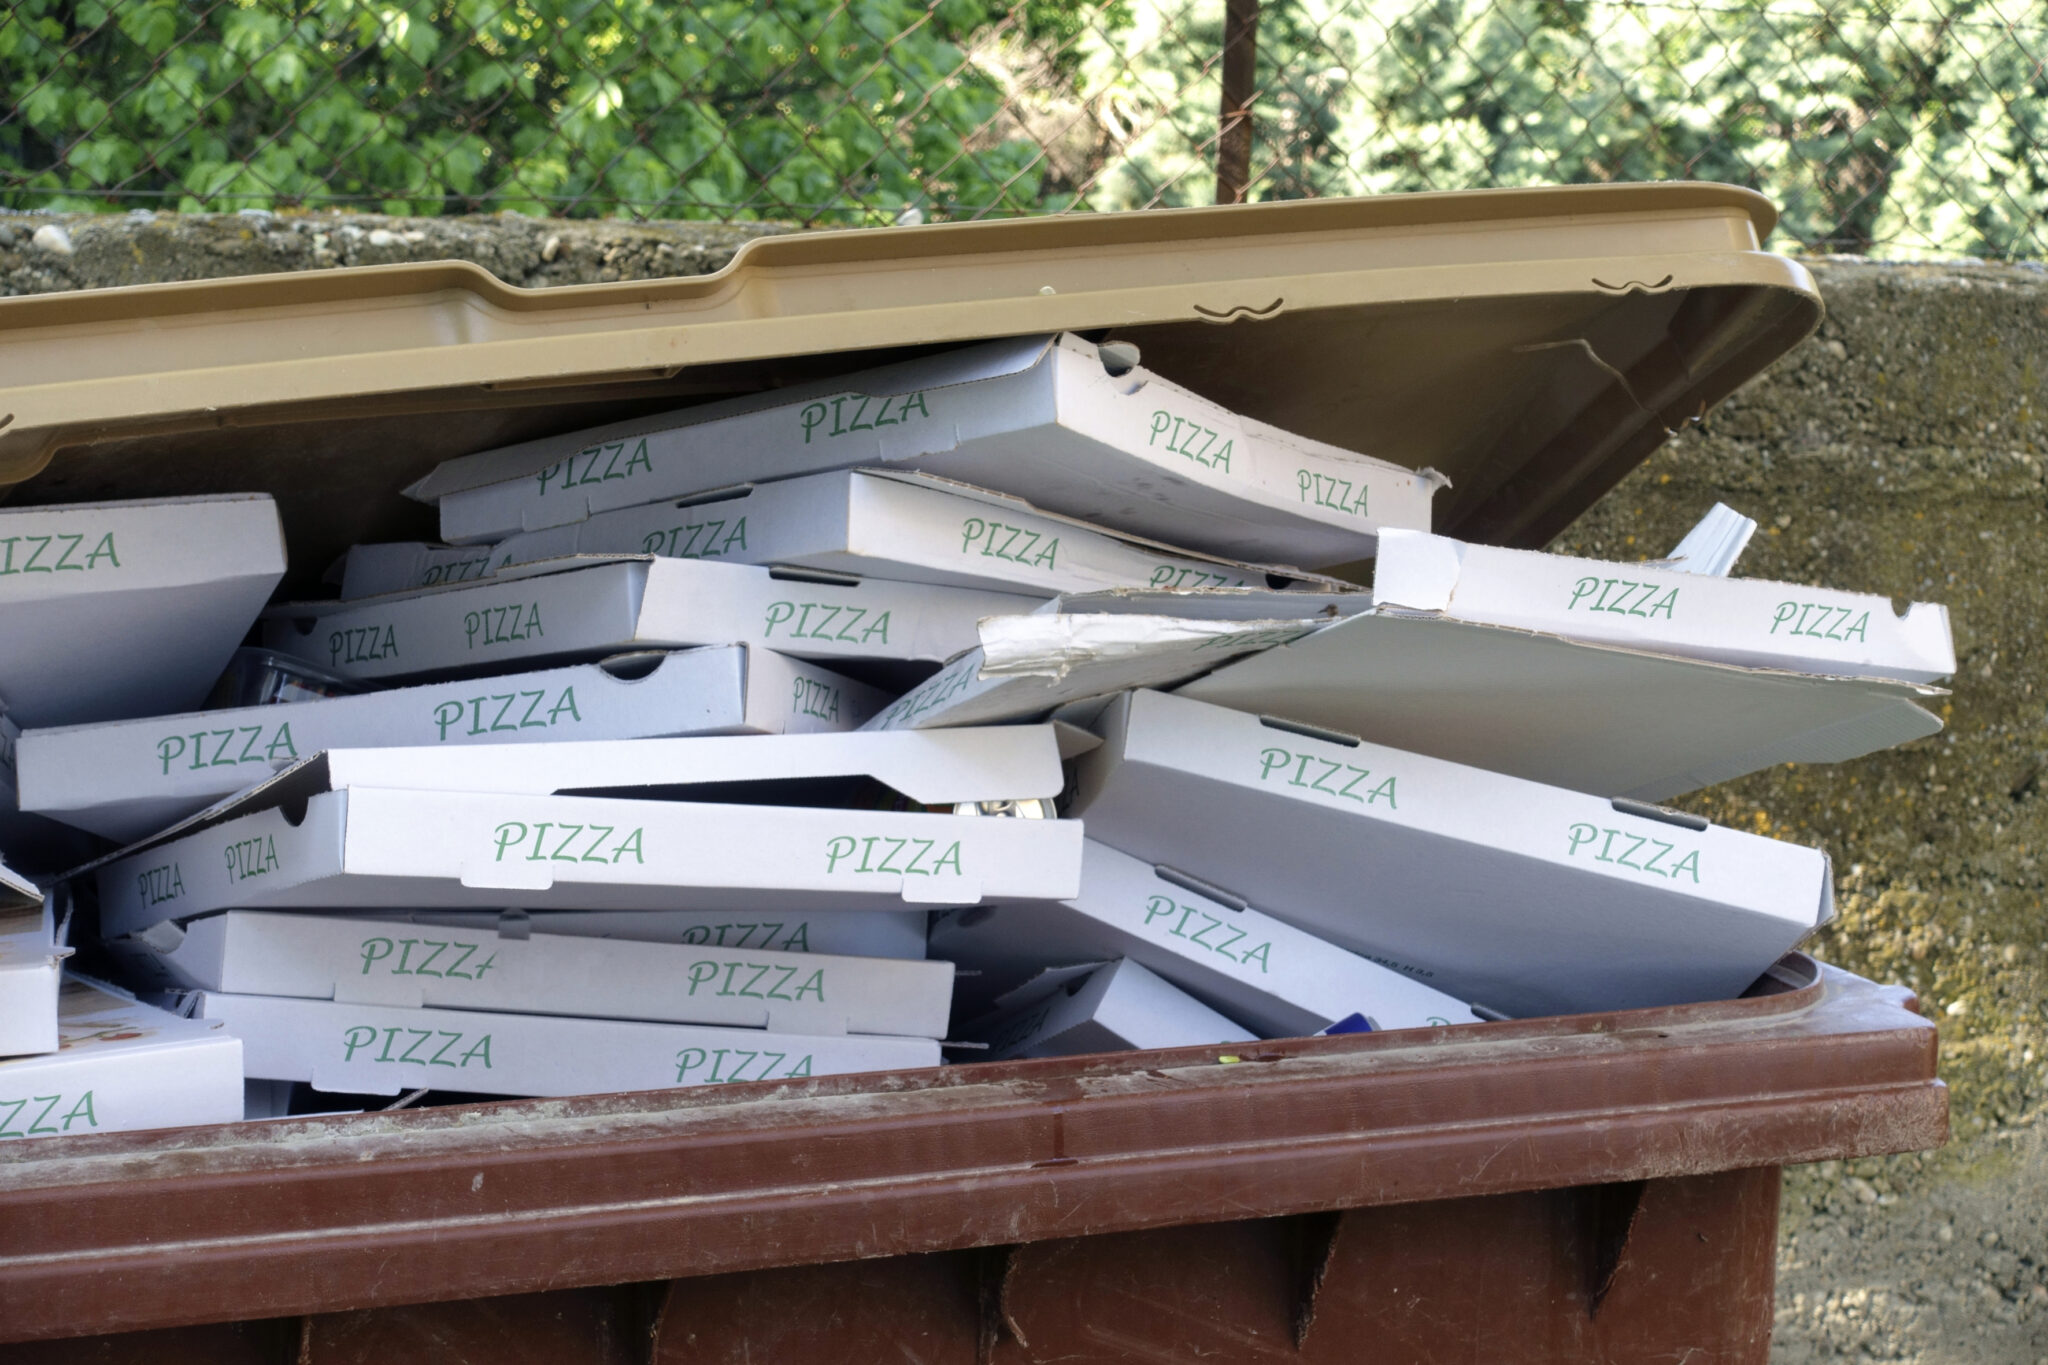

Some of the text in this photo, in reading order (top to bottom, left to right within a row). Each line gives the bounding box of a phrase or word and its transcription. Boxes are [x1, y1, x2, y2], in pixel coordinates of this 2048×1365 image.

[801, 392, 929, 444] PIZZA
[1149, 410, 1234, 474] PIZZA
[537, 438, 652, 496] PIZZA
[1297, 469, 1369, 517] PIZZA
[0, 532, 120, 576] IZZA
[641, 516, 747, 559] PIZZA
[962, 517, 1059, 570] PIZZA
[1567, 576, 1679, 619] PIZZA
[329, 624, 399, 667] PIZZA
[465, 603, 542, 648] PIZZA
[764, 601, 891, 645] PIZZA
[1769, 601, 1870, 643] PIZZA
[434, 686, 581, 741] PIZZA
[793, 676, 839, 723] PIZZA
[880, 663, 976, 730] PIZZA
[157, 721, 298, 775] PIZZA
[1260, 747, 1397, 809] PIZZA
[224, 833, 279, 884] PIZZA
[495, 822, 643, 864] PIZZA
[827, 836, 962, 876] PIZZA
[1567, 823, 1700, 883] PIZZA
[137, 862, 185, 910] PIZZA
[682, 922, 809, 951] PIZZA
[1144, 895, 1272, 974] PIZZA
[687, 960, 825, 1002] PIZZA
[344, 1026, 491, 1069] PIZZA
[675, 1047, 813, 1083] PIZZA
[0, 1090, 98, 1137] ZZA
